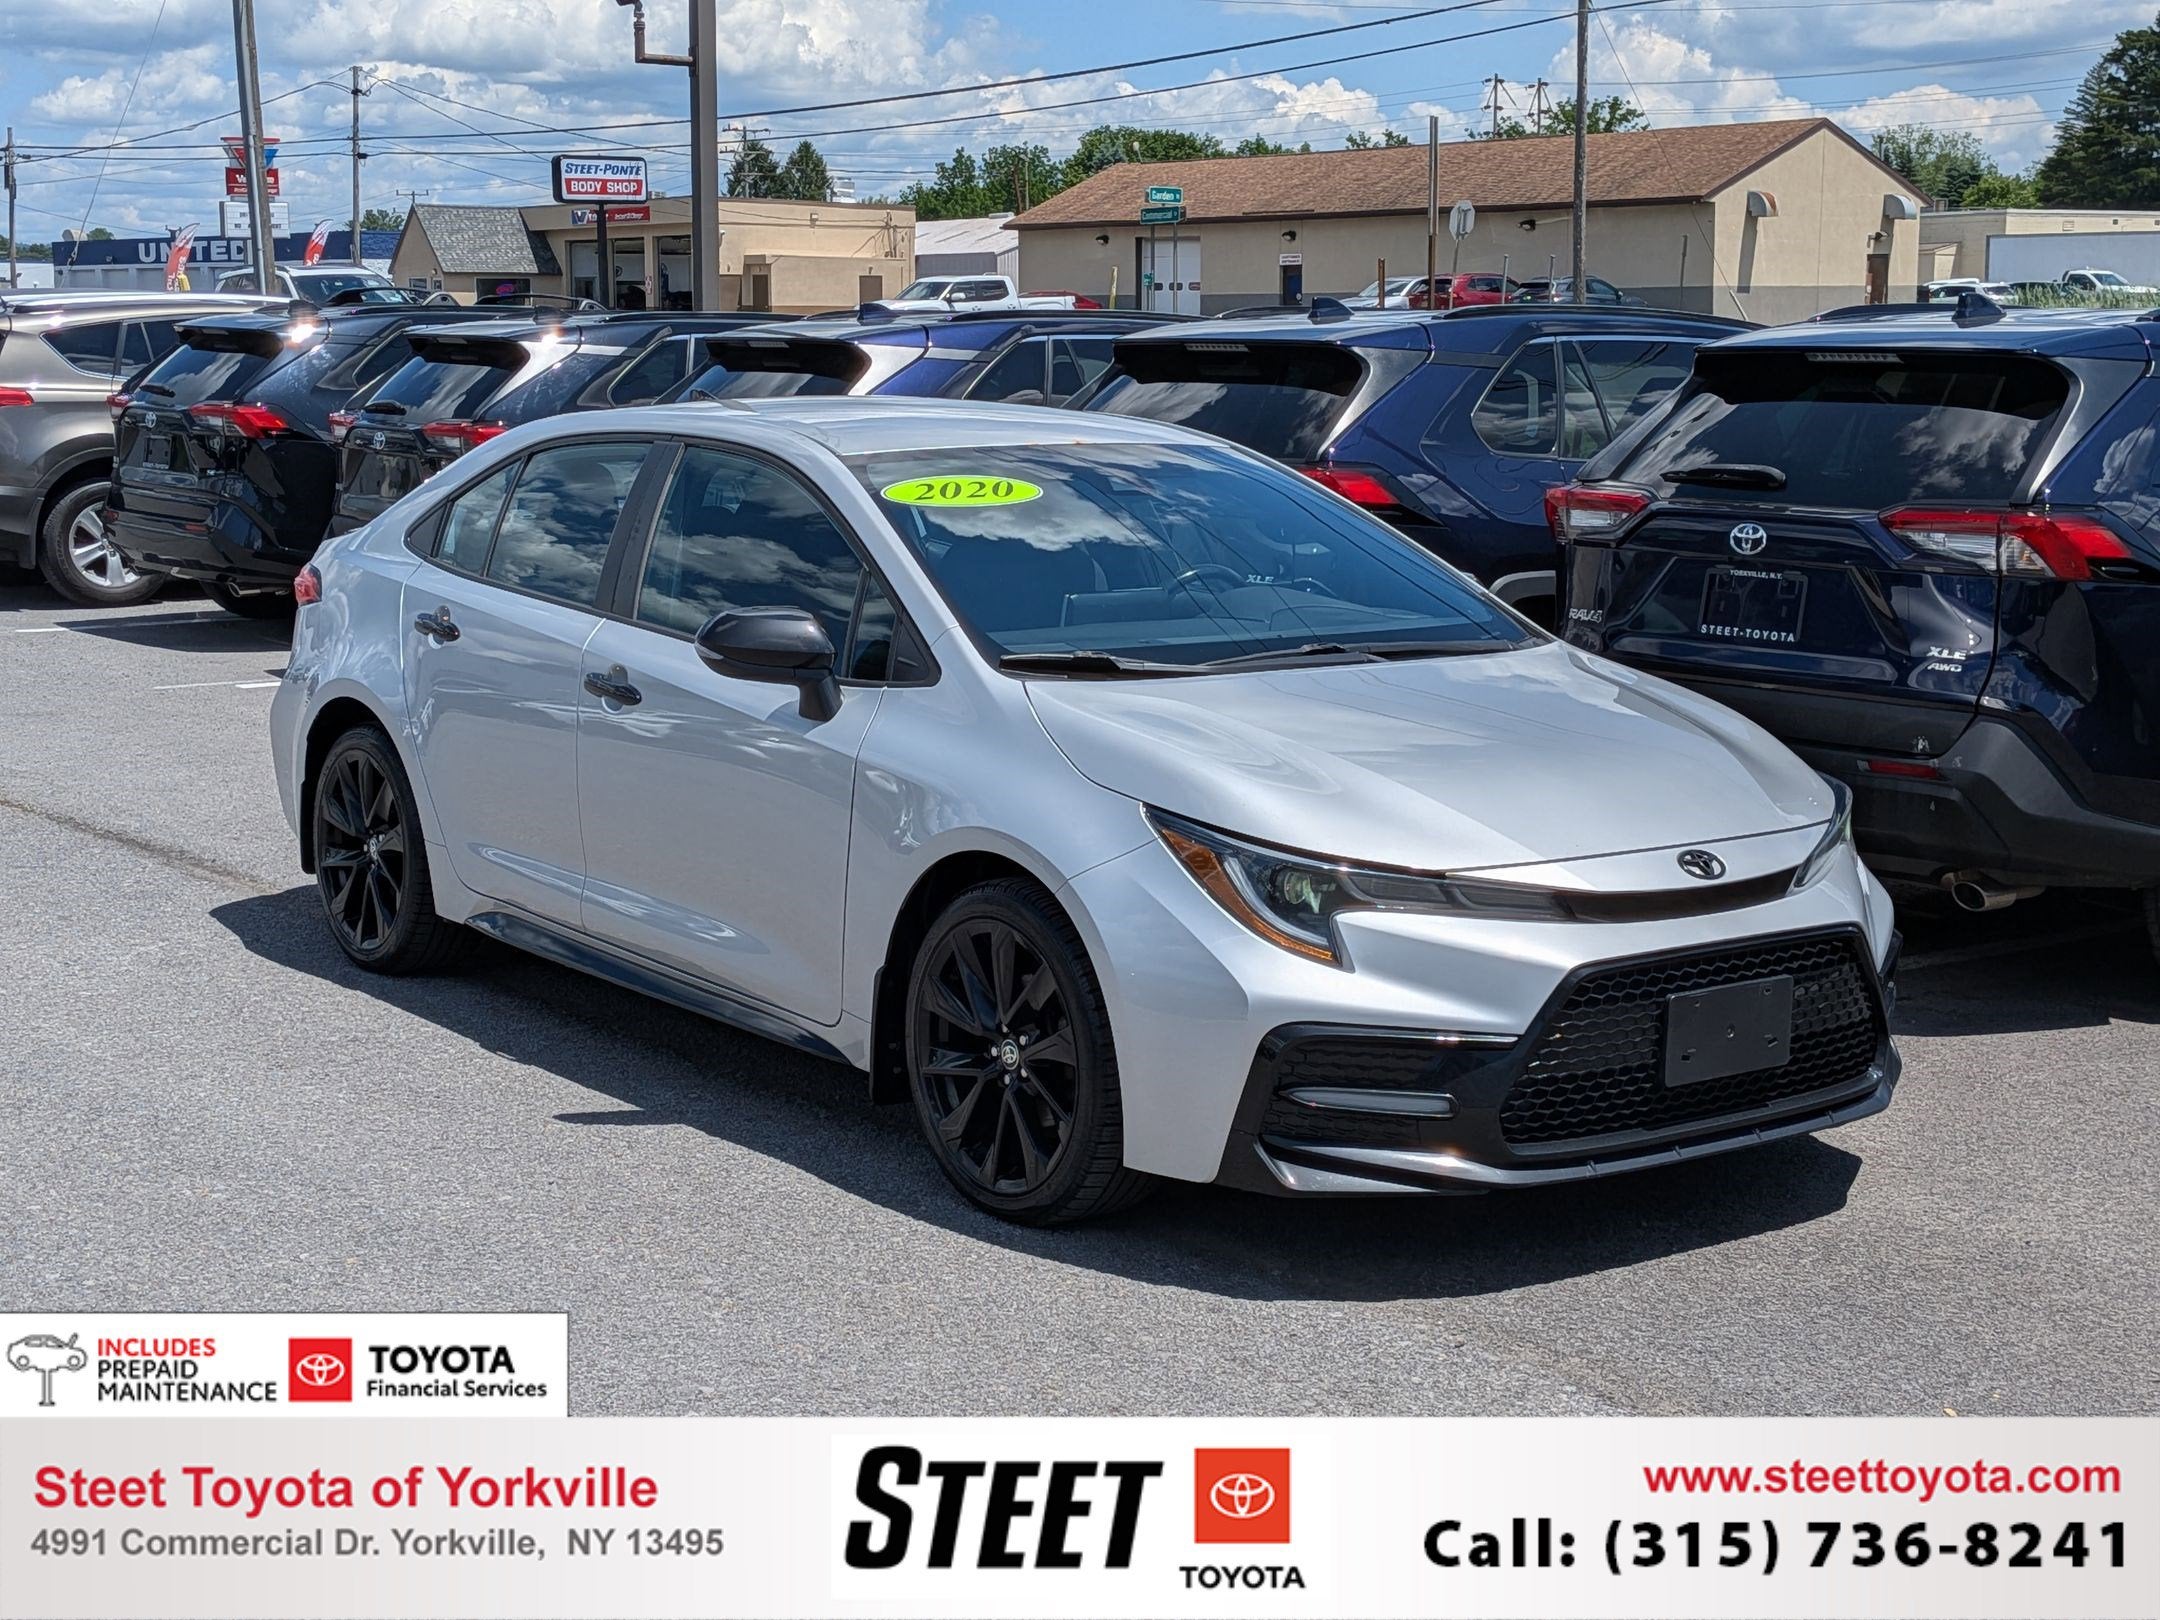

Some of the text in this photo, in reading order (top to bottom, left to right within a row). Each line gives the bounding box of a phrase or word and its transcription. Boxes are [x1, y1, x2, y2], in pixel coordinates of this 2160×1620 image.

[564, 162, 642, 176] STEET-PONTE
[571, 181, 637, 193] BODY SHOP
[138, 240, 245, 263] UNTED
[914, 480, 1014, 501] 2020
[1568, 607, 1603, 624] RAV4
[1700, 624, 1796, 643] STEET-TOYOTA
[1926, 646, 1968, 660] XLE
[1927, 662, 1962, 673] AWD
